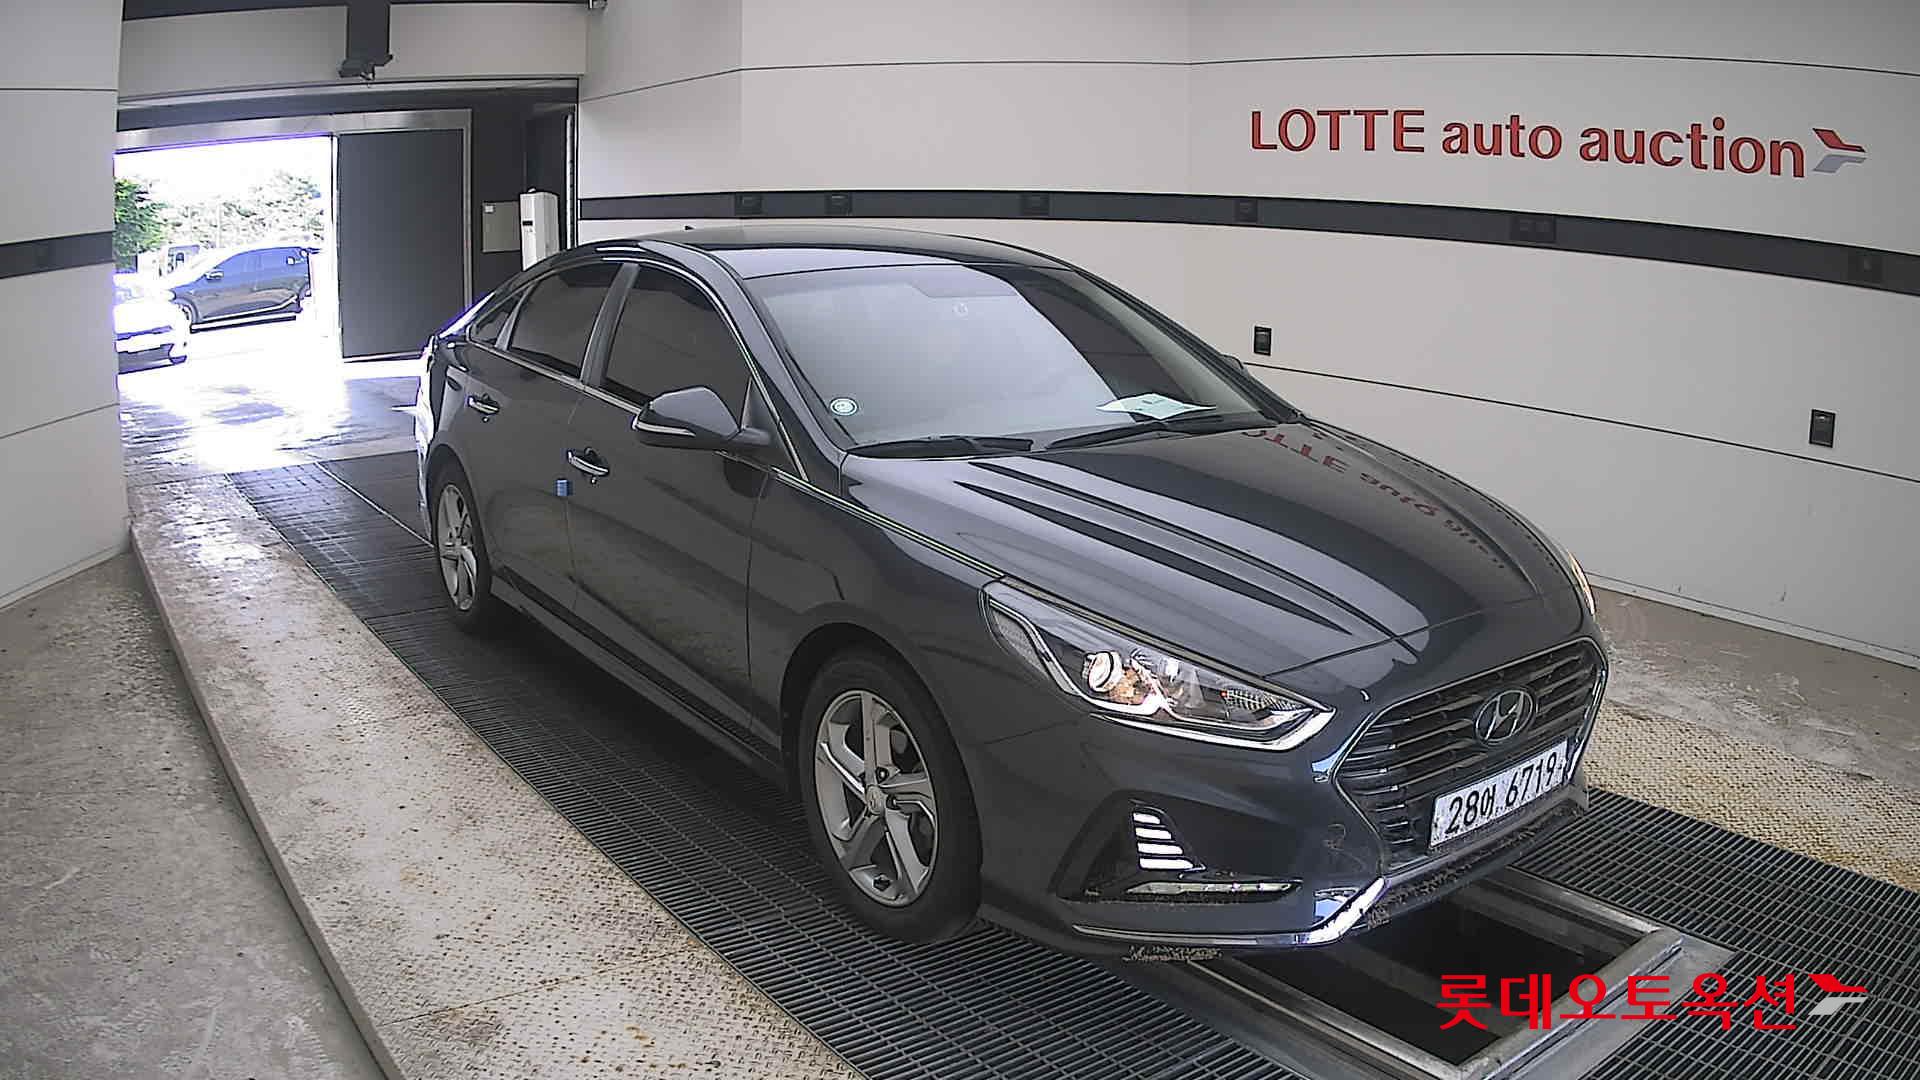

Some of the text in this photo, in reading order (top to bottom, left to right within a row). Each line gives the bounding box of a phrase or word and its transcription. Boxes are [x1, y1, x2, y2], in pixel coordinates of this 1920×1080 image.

[1250, 109, 1805, 178] LOTTE auto auction
[1444, 751, 1557, 834] 28어 6719
